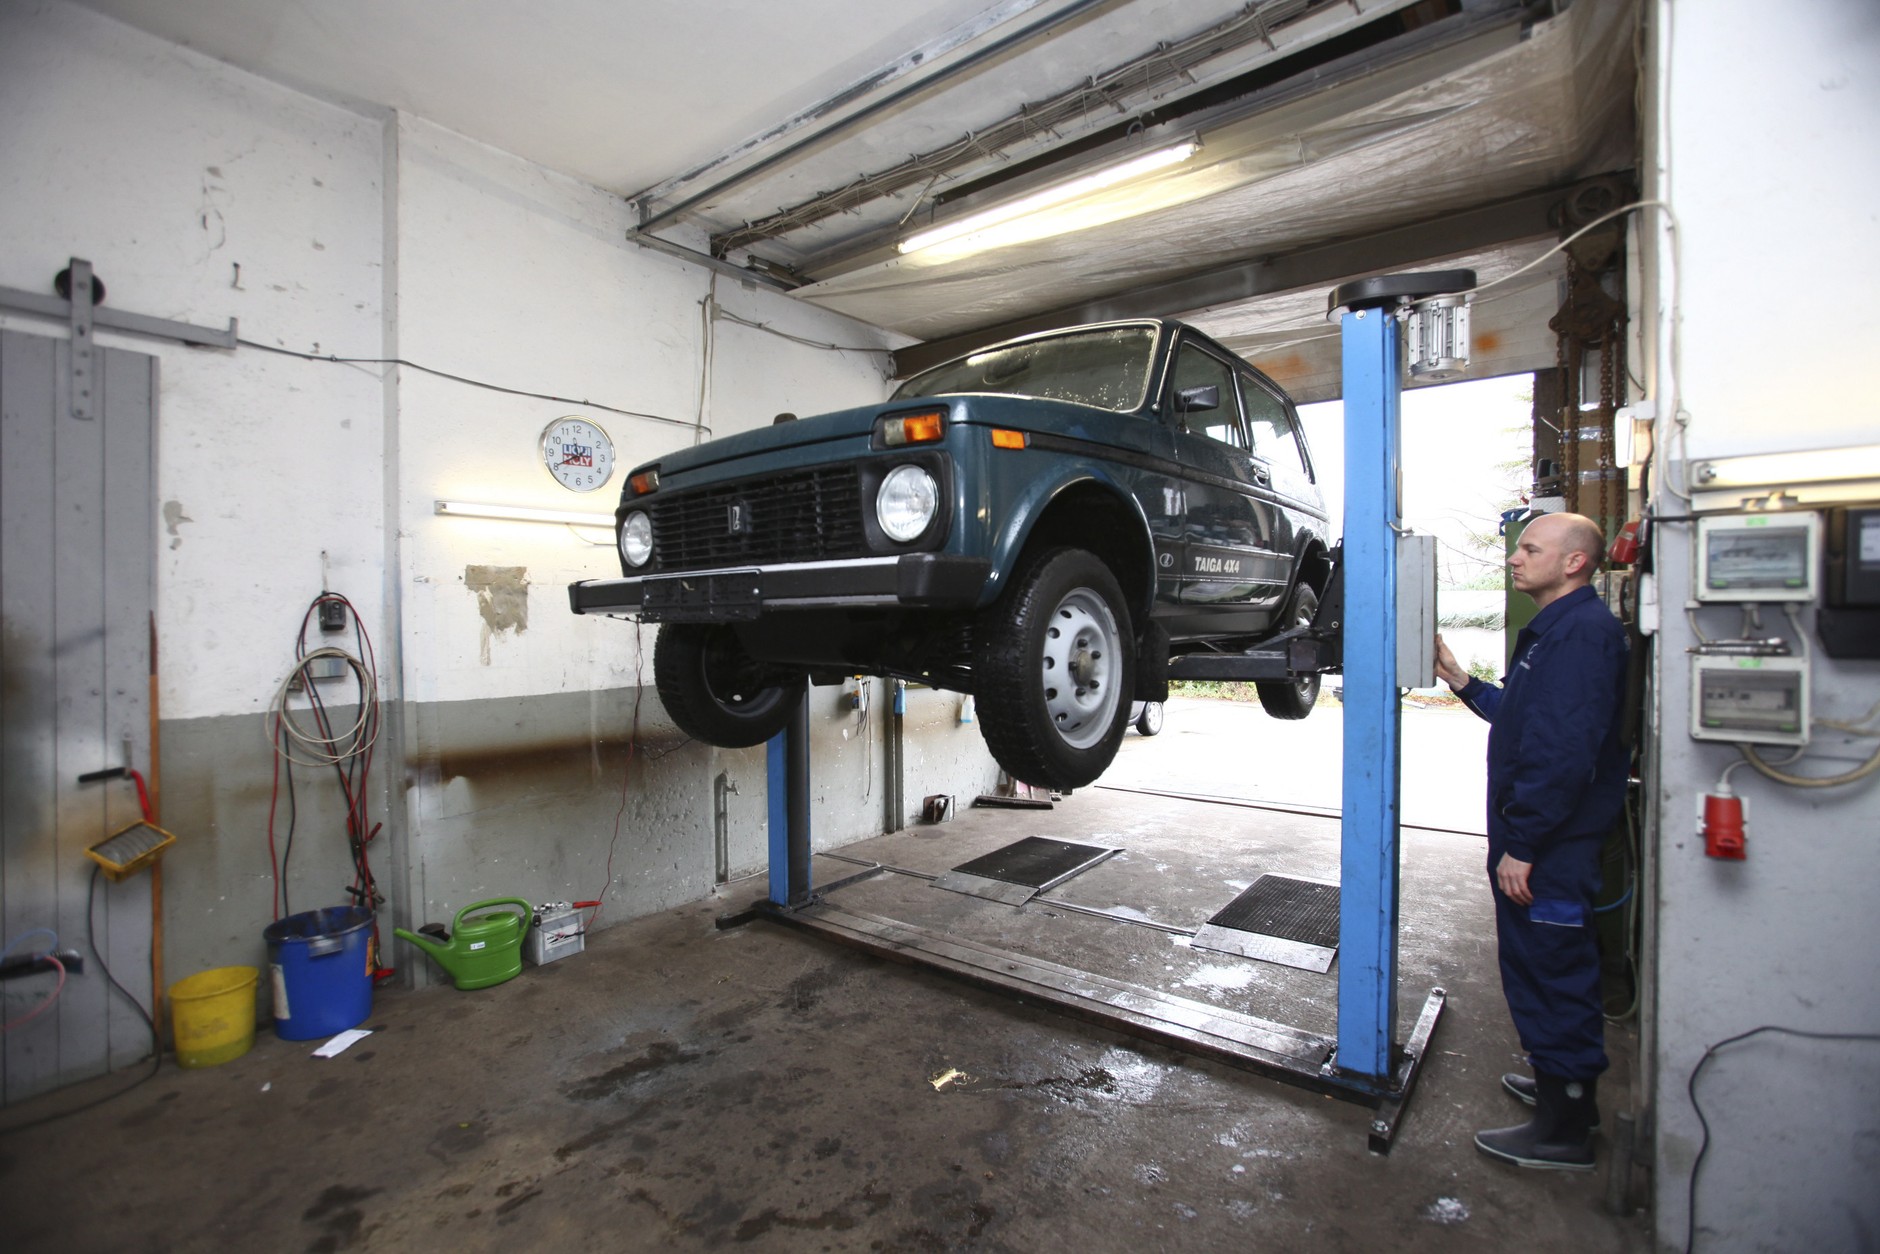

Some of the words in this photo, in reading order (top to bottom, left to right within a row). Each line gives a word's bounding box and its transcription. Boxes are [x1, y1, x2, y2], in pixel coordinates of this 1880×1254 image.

[562, 428, 569, 436] 11
[572, 425, 582, 434] 12
[552, 436, 561, 444] 10
[548, 448, 554, 456] 9
[564, 445, 591, 456] LIQUI
[564, 454, 592, 466] MOLY
[554, 462, 559, 471] 8
[588, 476, 593, 484] 5
[1195, 556, 1222, 572] TAIGA
